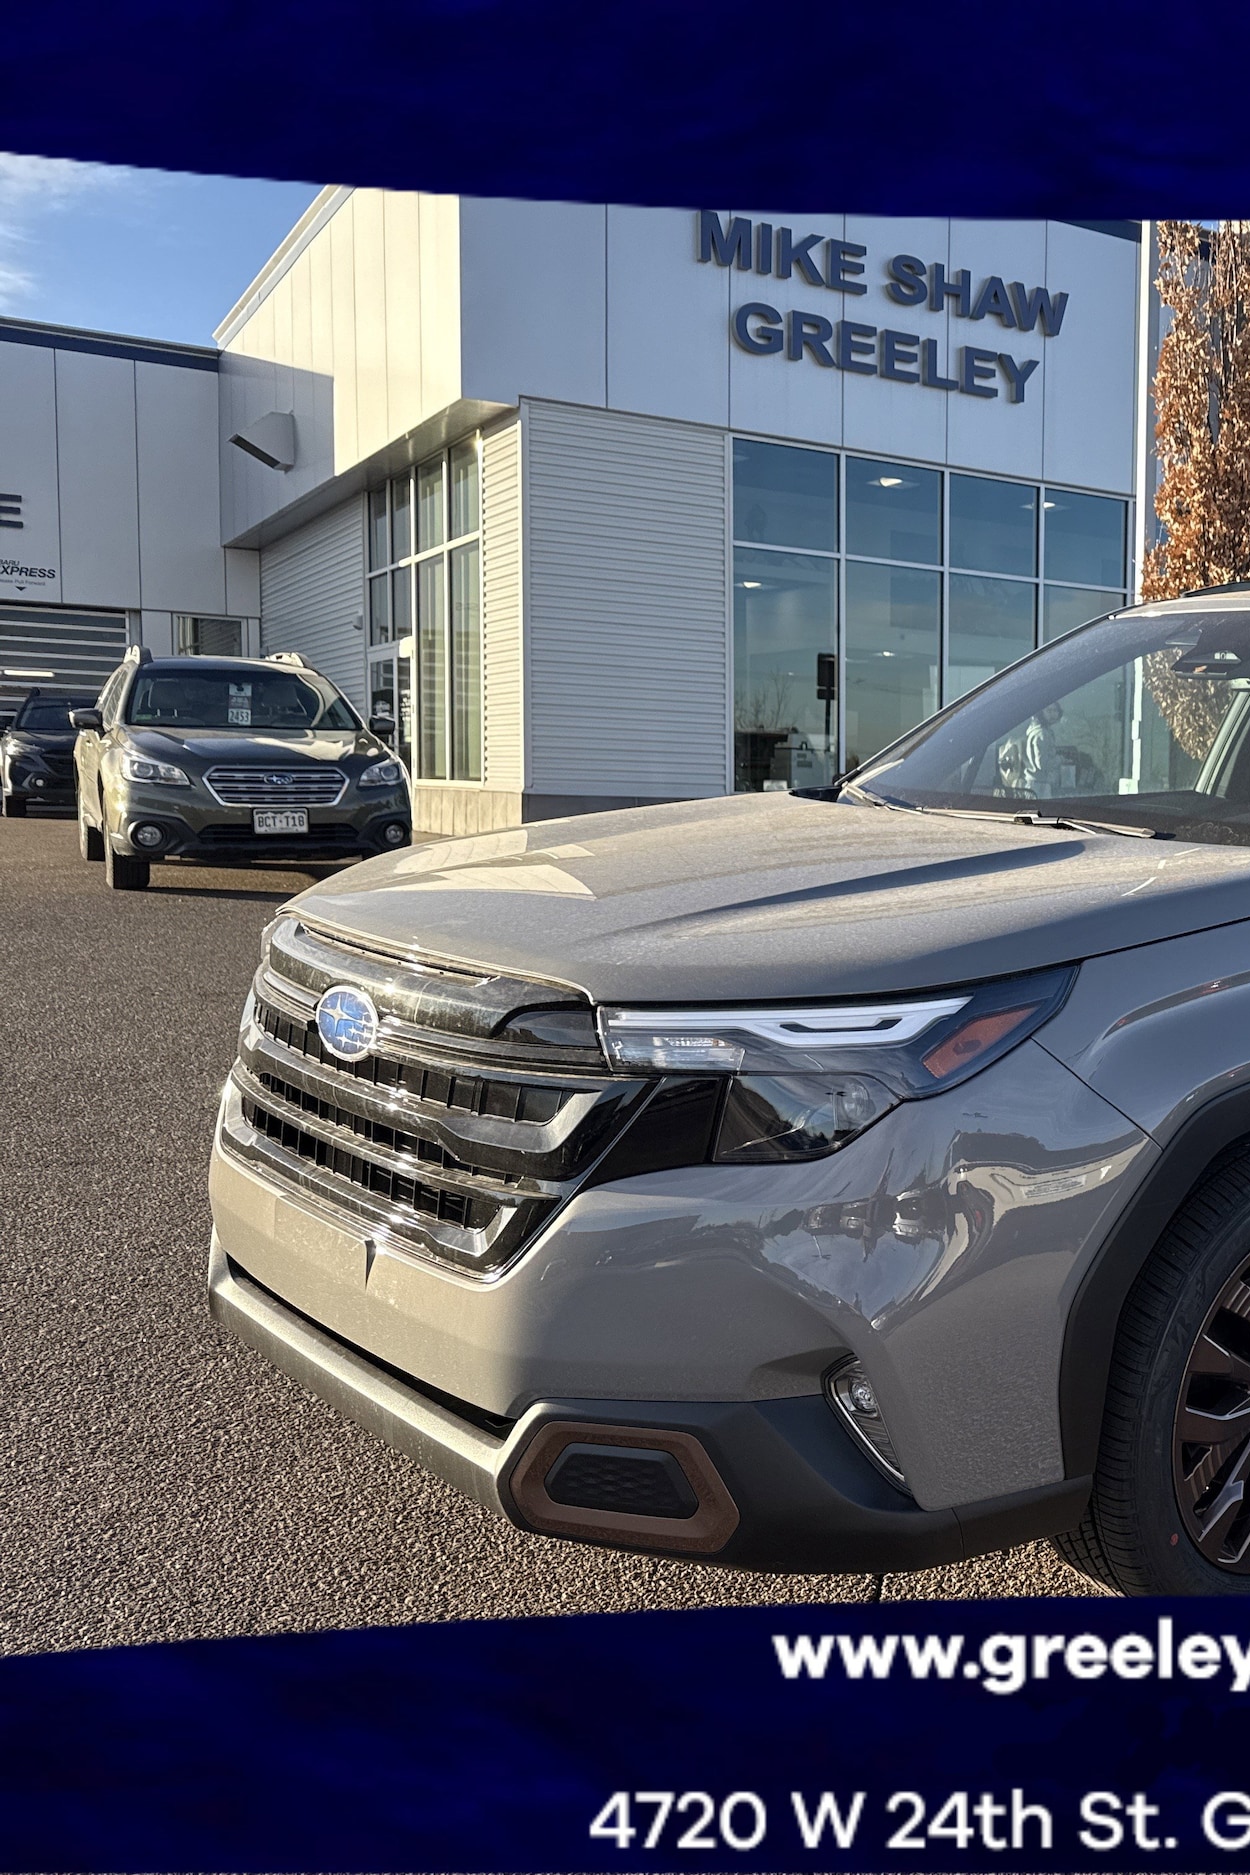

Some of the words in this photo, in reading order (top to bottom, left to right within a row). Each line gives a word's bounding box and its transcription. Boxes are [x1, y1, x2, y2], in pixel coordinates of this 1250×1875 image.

[697, 208, 868, 296] MIKE
[885, 253, 1070, 337] SHAW
[731, 301, 1041, 404] GREELEY
[0, 564, 56, 579] XPRESS
